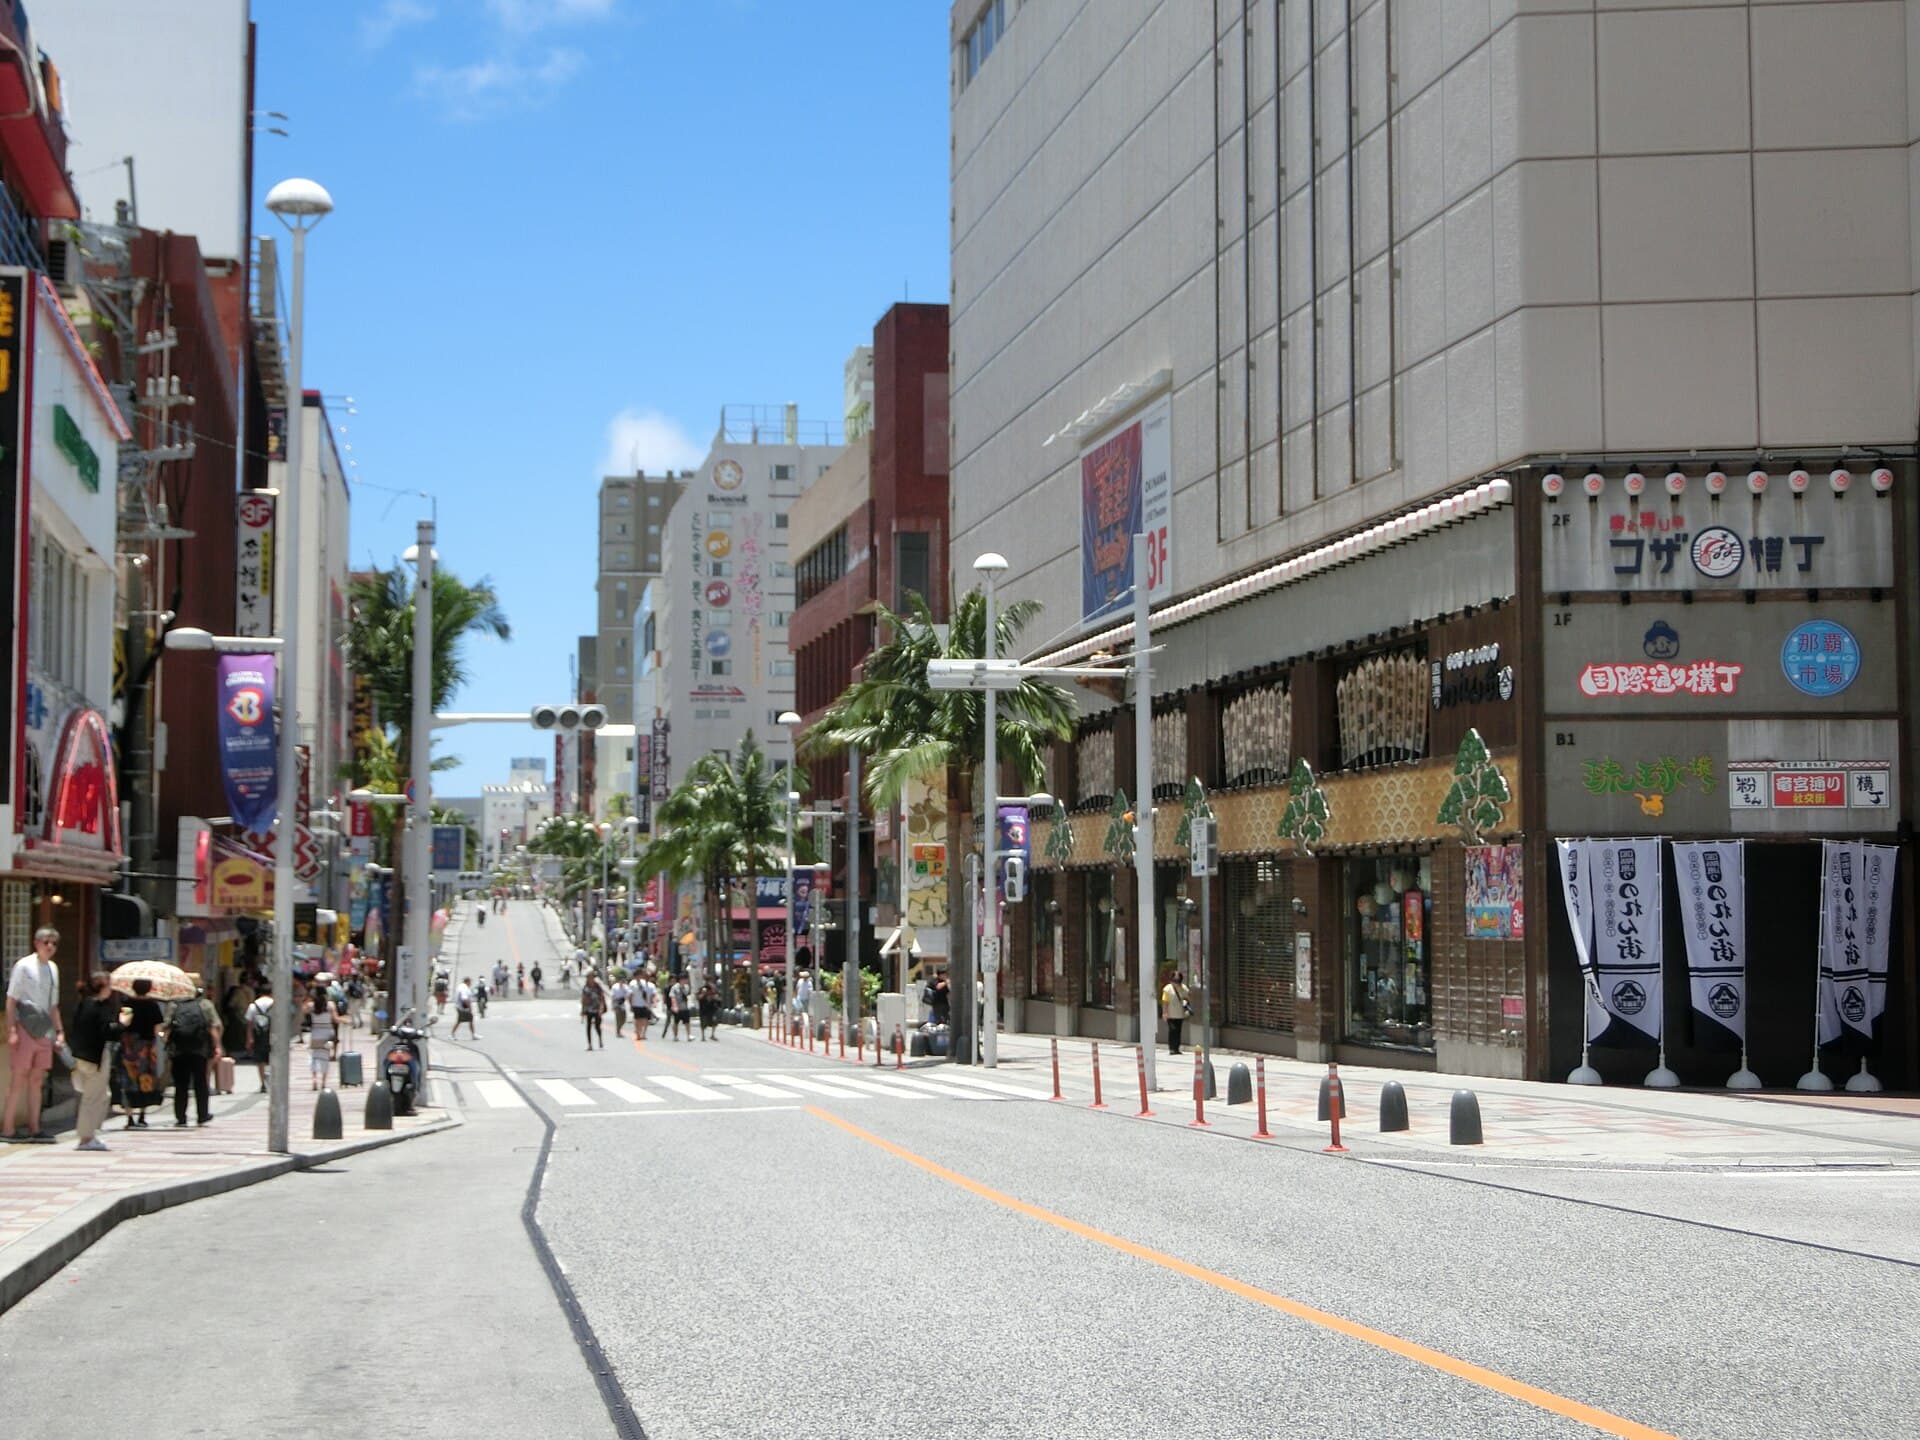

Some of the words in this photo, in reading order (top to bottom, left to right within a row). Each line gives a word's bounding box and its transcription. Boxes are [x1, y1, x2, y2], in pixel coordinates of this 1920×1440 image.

[1552, 514, 1570, 526] 2F
[1147, 526, 1168, 591] 3F
[1609, 533, 1689, 574] コザ
[1749, 536, 1824, 572] 横丁
[1554, 613, 1572, 626] 1F
[1799, 632, 1843, 653] 那覇
[1580, 662, 1741, 695] 国際通り横丁
[1799, 665, 1844, 685] 市場
[1556, 733, 1576, 746] B1
[1736, 775, 1762, 805] 粉もん
[1776, 776, 1841, 792] 竜宮通り
[1856, 775, 1884, 804] 横丁
